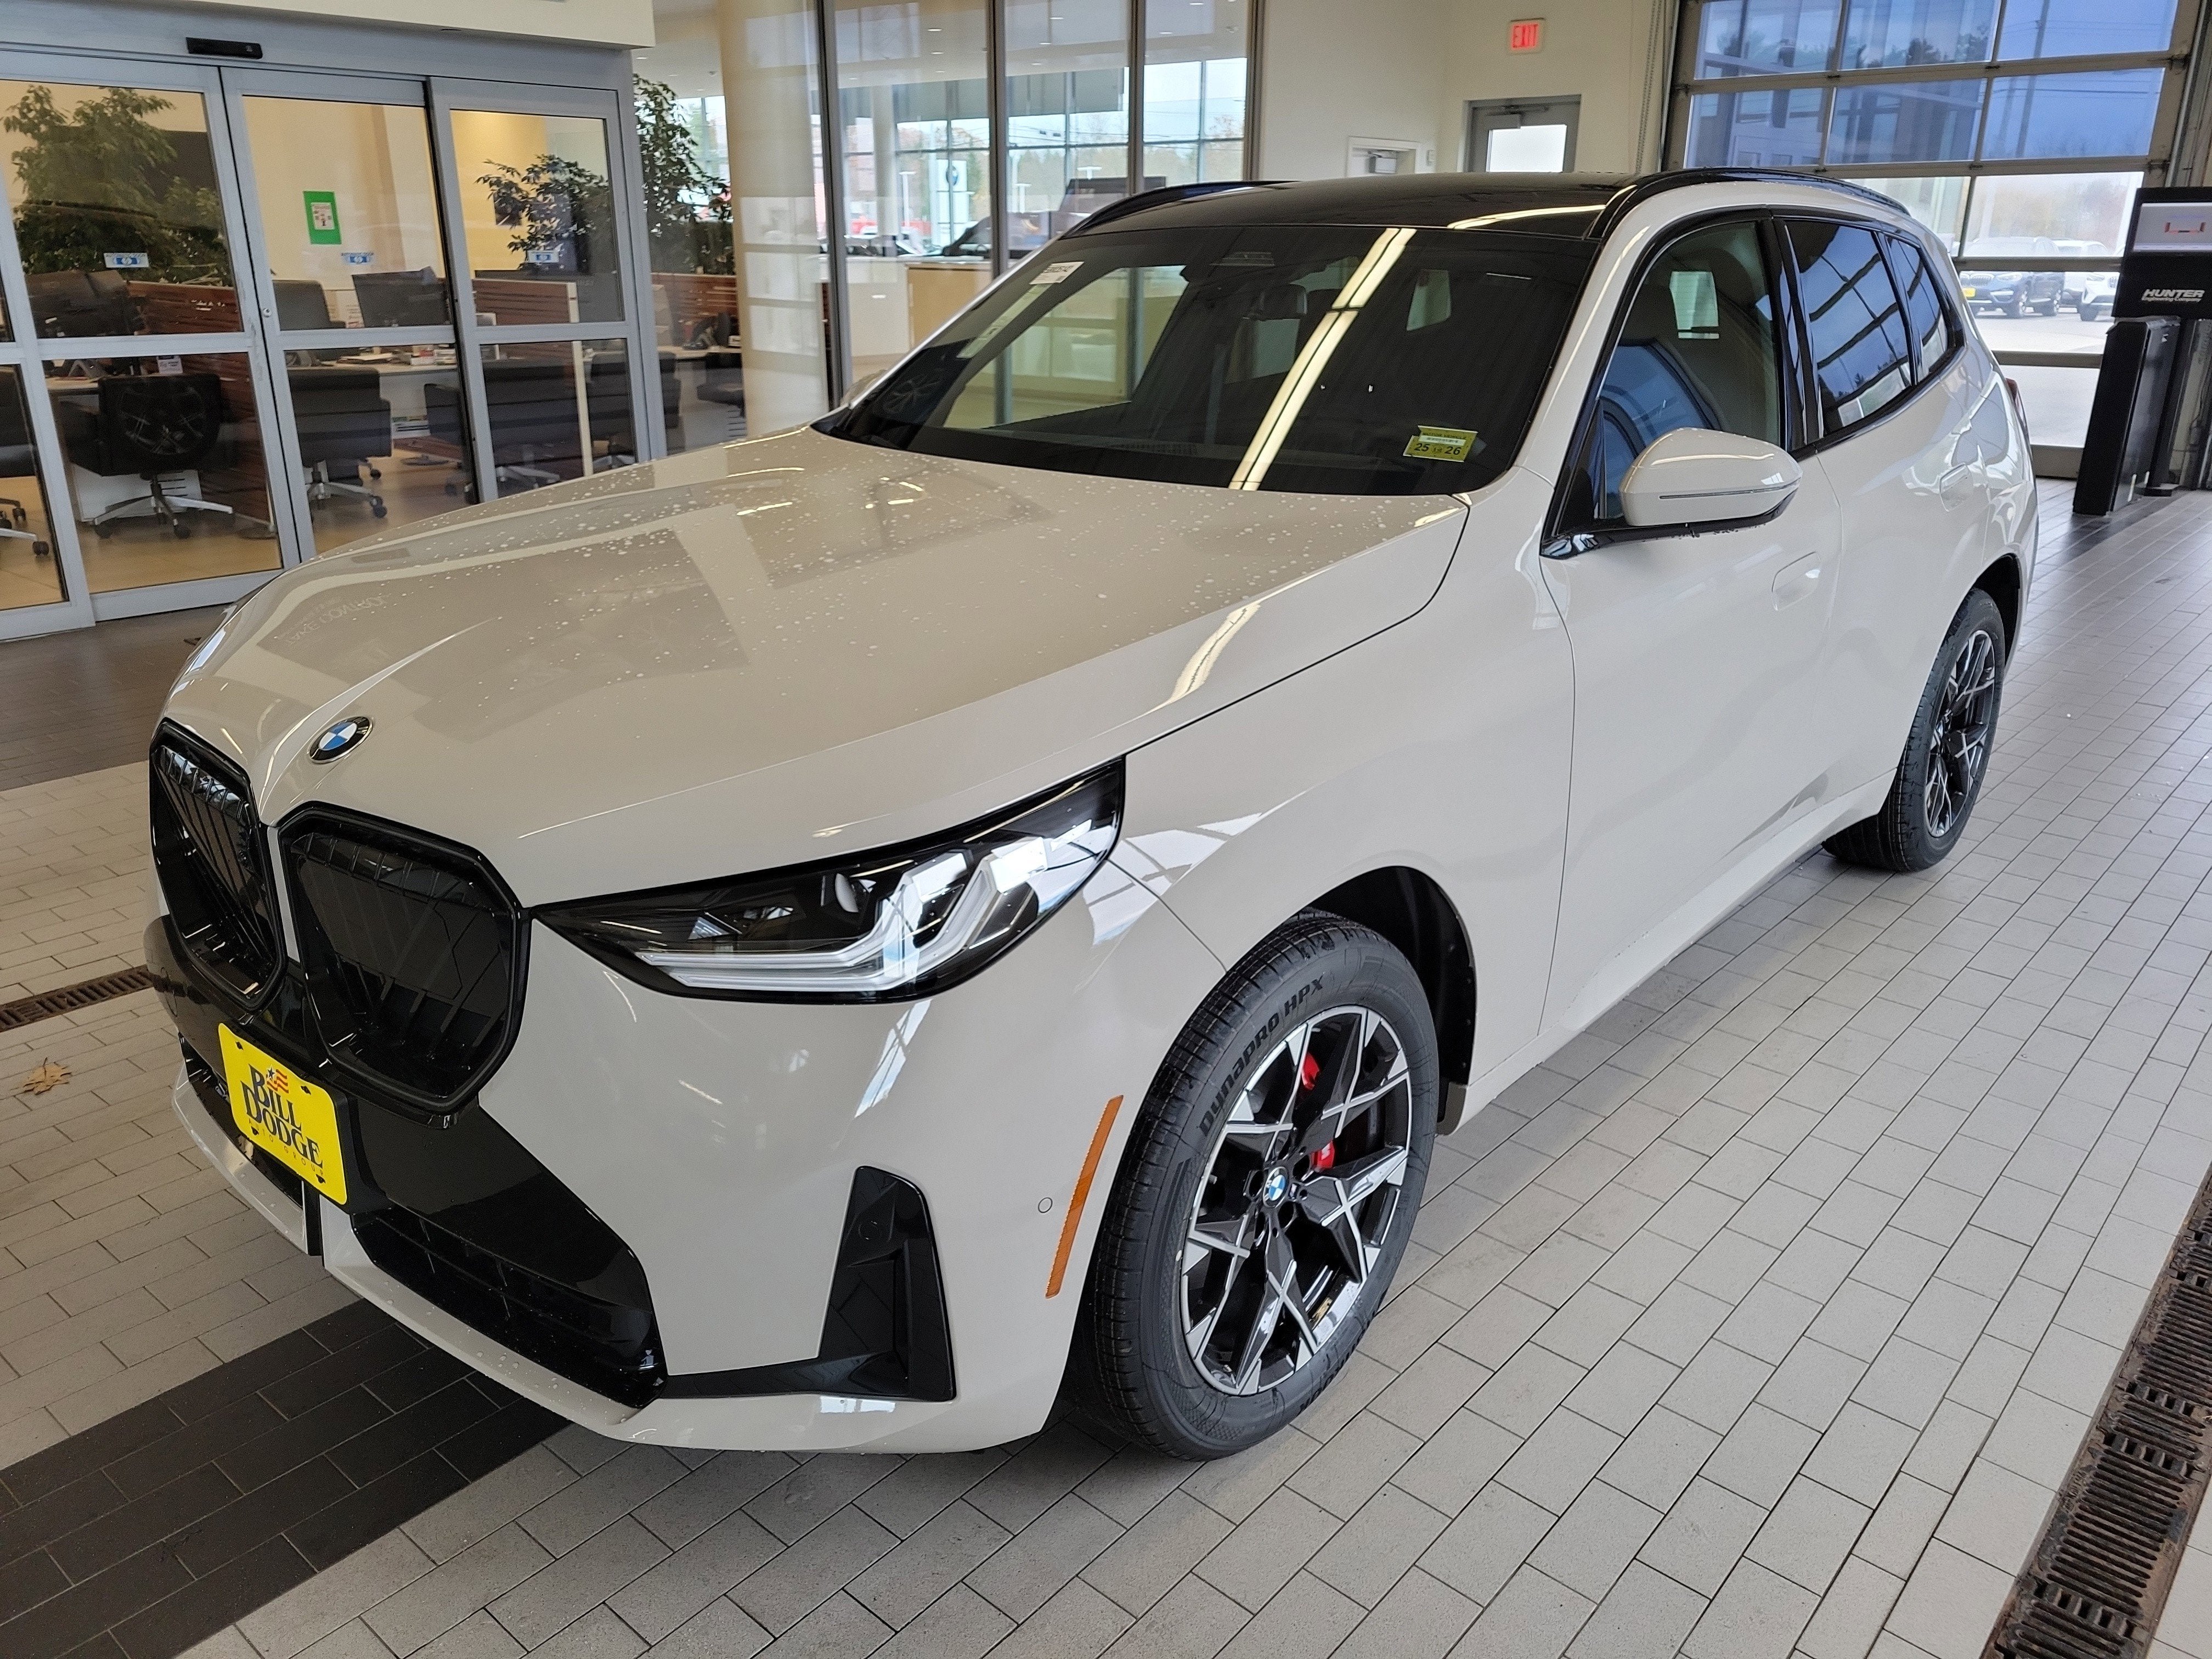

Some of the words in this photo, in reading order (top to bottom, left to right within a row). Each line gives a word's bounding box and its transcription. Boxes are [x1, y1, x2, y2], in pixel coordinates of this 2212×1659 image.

[1513, 24, 1538, 48] EXIT
[2142, 289, 2205, 298] HUNTER
[1414, 443, 1430, 452] 25
[1444, 446, 1462, 455] 26
[1284, 975, 1324, 1017] HPX
[249, 1063, 302, 1131] BILL
[240, 1080, 323, 1169] DODGE
[284, 1145, 324, 1176] GROUP
